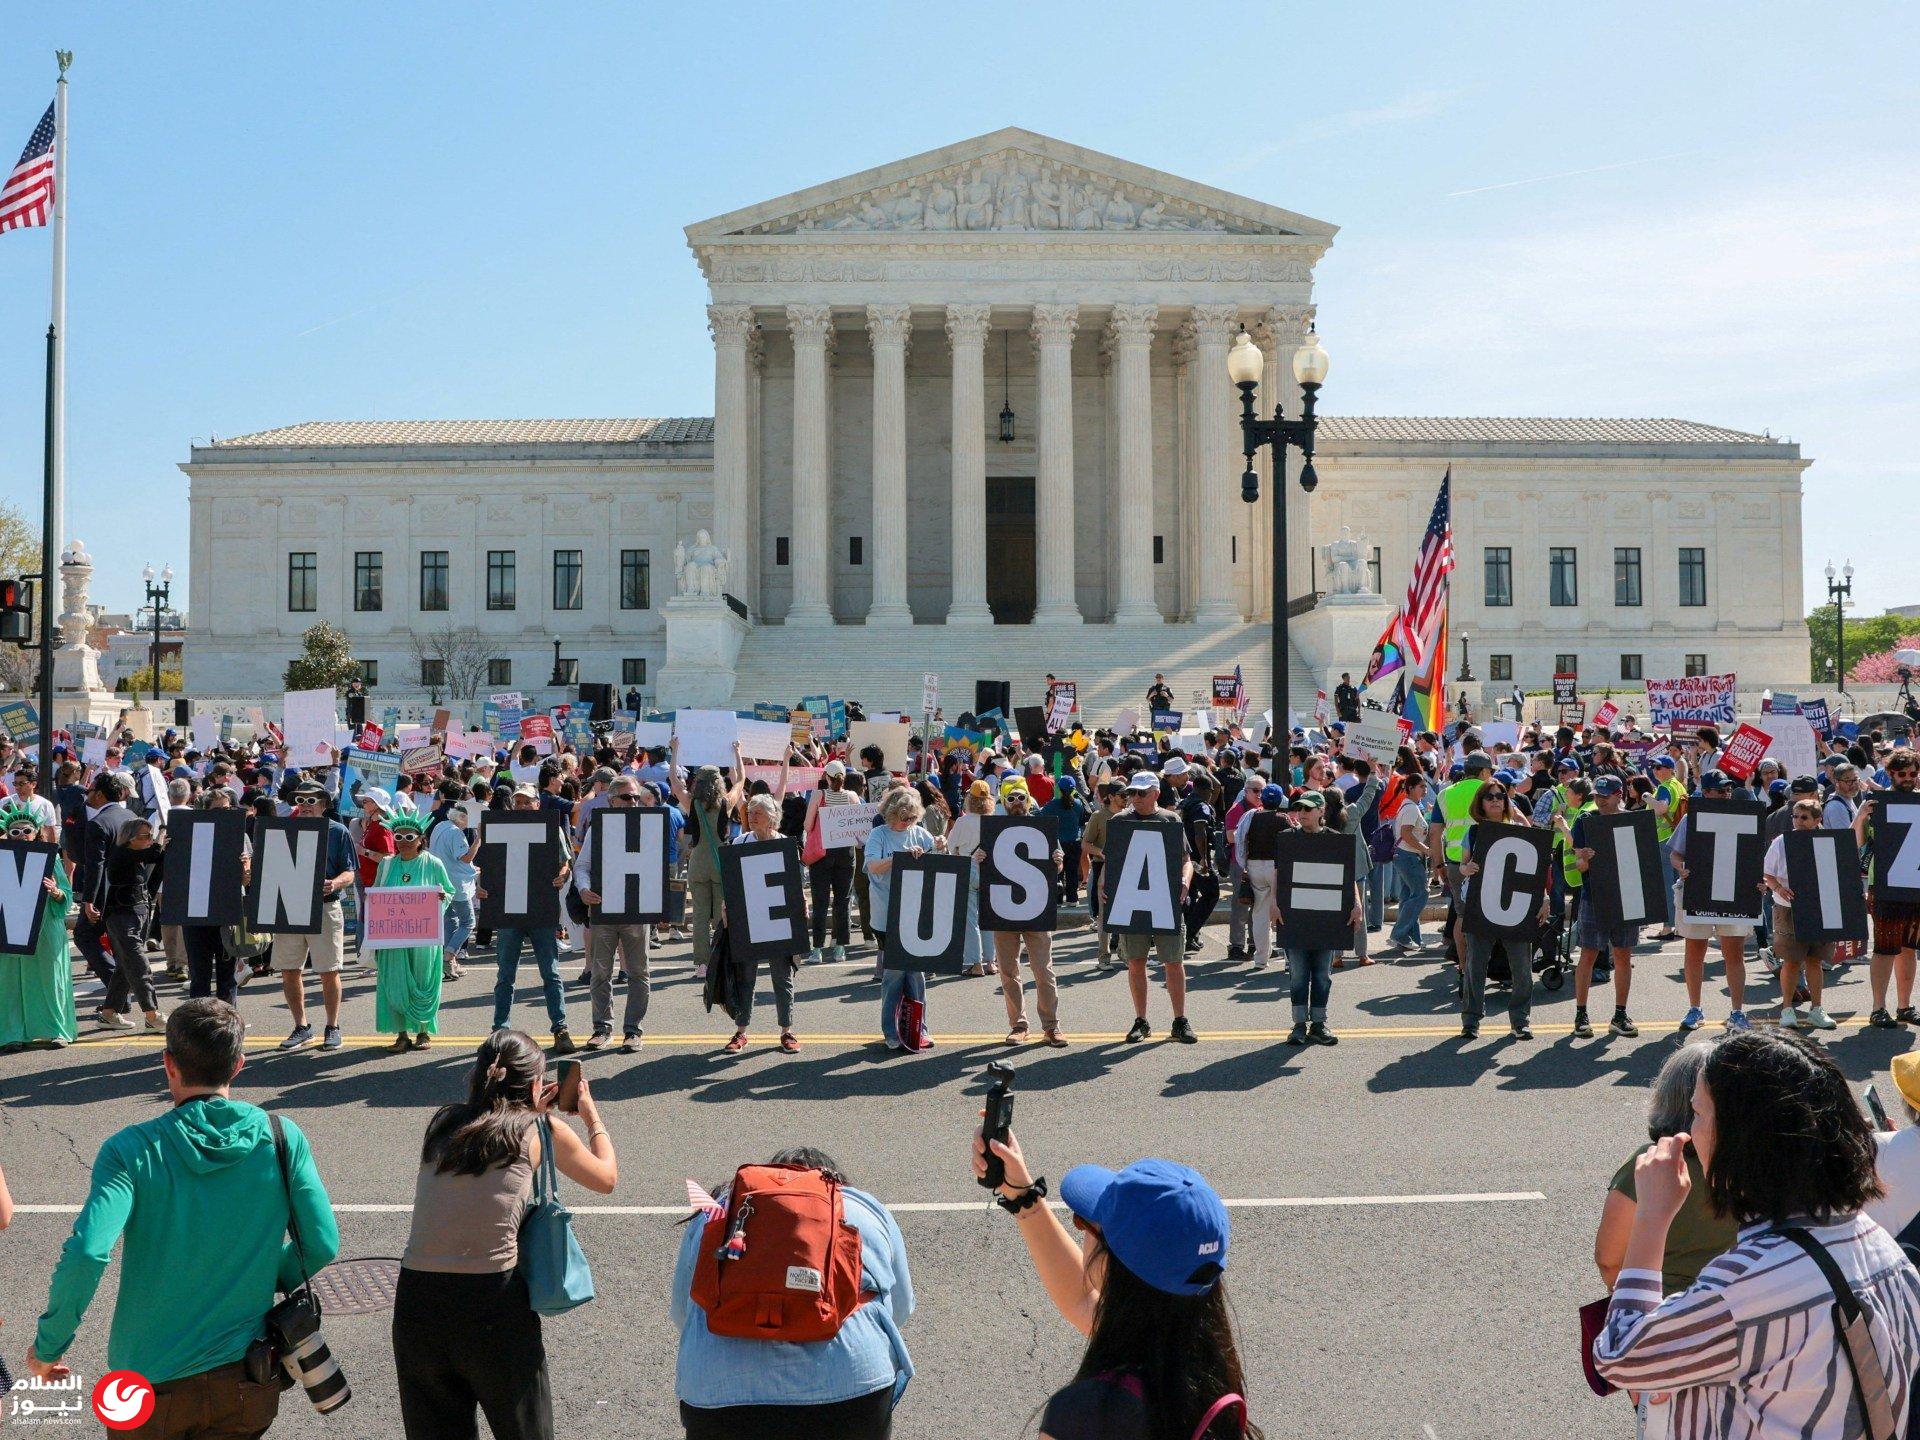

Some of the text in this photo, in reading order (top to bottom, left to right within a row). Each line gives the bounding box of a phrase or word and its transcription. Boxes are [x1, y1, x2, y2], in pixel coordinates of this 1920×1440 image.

[1734, 733, 1765, 756] BIRTH
[1728, 745, 1760, 765] RIGHT
[187, 822, 319, 926] IN
[485, 813, 794, 944] THE
[370, 893, 427, 905] CITIZENSHIP
[899, 825, 1175, 958] USA
[388, 907, 406, 917] IS A
[369, 917, 431, 935] BIRTHRIGHT
[1198, 1240, 1219, 1256] ACLU
